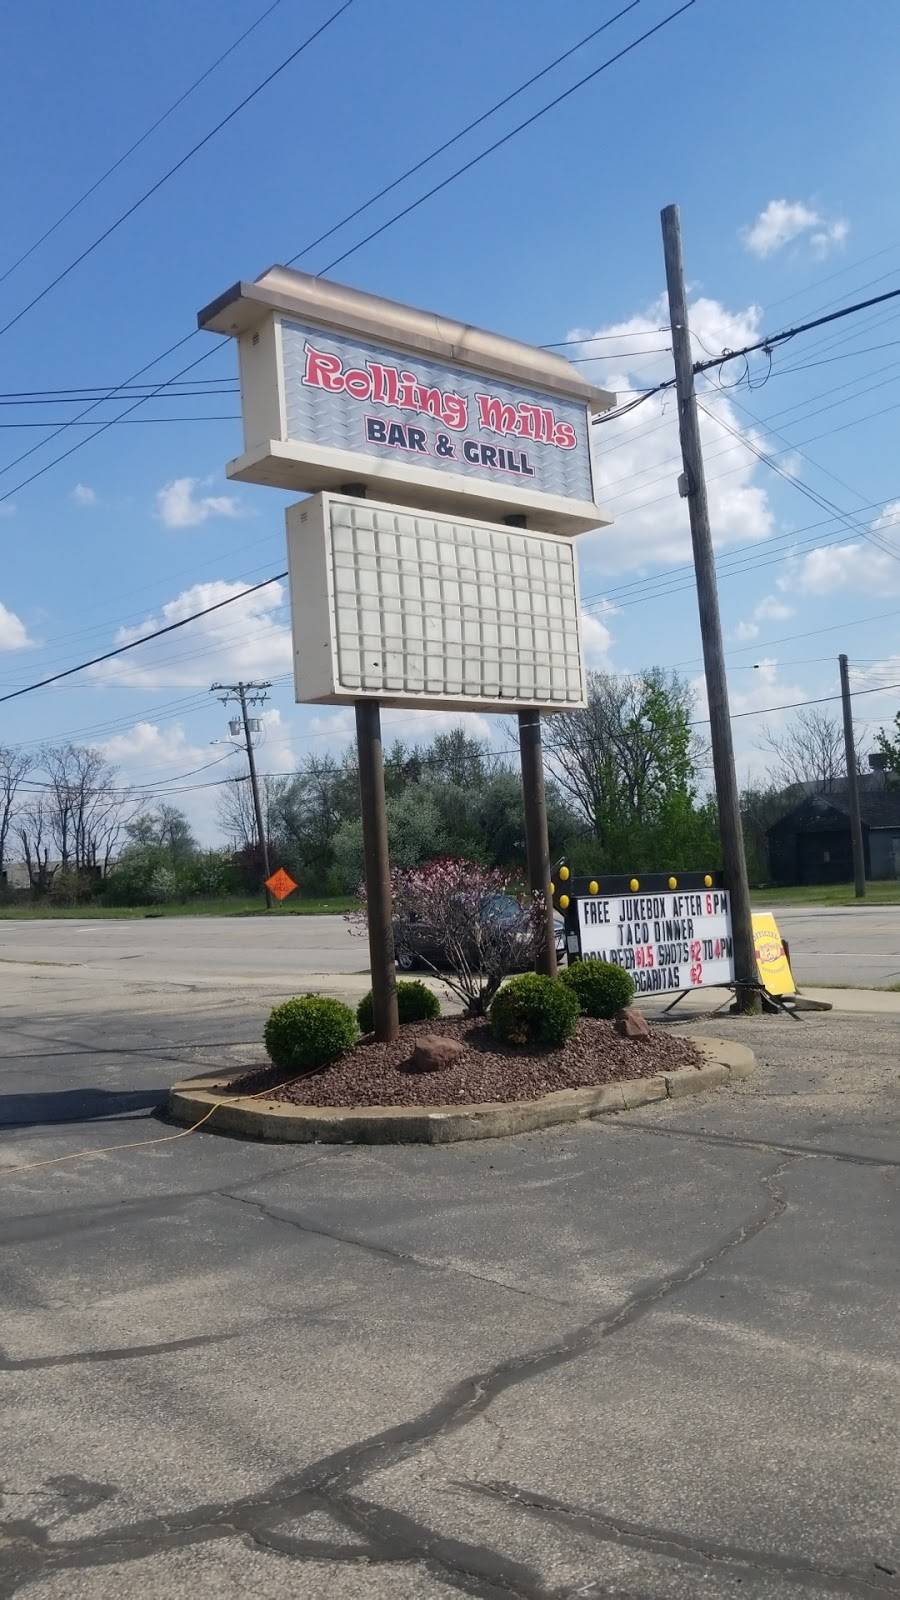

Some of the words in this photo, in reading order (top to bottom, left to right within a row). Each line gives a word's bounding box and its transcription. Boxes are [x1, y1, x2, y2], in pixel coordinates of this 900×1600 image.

[301, 341, 468, 432] Rolling
[475, 392, 578, 450] Mills
[366, 417, 428, 454] BAR
[437, 433, 456, 458] &
[464, 441, 535, 476] GRILL
[584, 901, 610, 924] FREE
[620, 897, 666, 922] JUKEBOX
[673, 895, 702, 917] AFTER
[618, 922, 649, 946] TACO
[654, 919, 694, 943] DINNER
[658, 940, 688, 966] SHOTS
[690, 939, 701, 963] $2
[703, 939, 713, 961] TO
[633, 966, 680, 992] RGARITAS
[690, 963, 703, 985] $2
